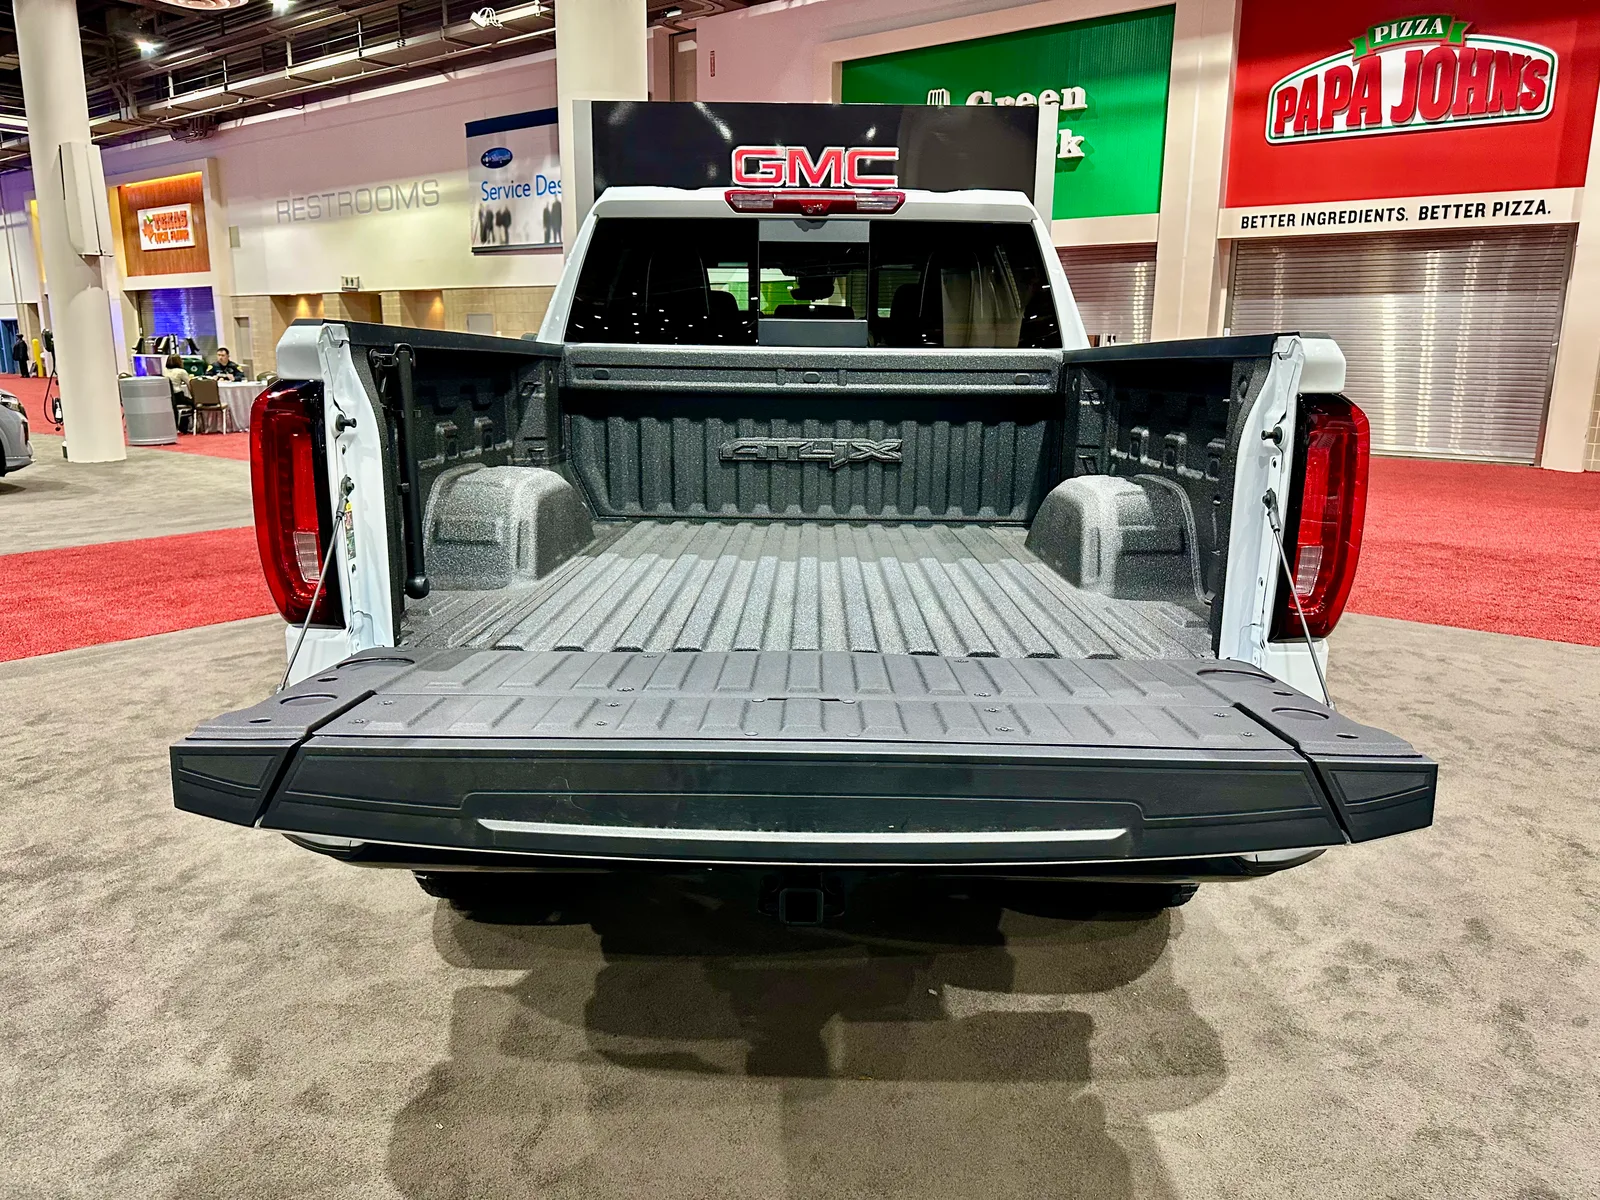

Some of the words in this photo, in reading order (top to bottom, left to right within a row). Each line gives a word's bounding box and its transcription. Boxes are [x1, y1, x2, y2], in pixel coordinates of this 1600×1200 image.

[1373, 17, 1444, 44] PIZZA
[1273, 55, 1382, 135] PAPA
[1390, 46, 1550, 125] JOHN'S
[731, 145, 899, 188] GMC
[276, 179, 439, 224] RESTROOMS
[481, 180, 531, 201] Service
[1241, 213, 1296, 229] BETTER
[1301, 206, 1409, 227] INGREDIENTS.
[1418, 202, 1486, 220] BETTER
[1492, 199, 1552, 217] PIZZA.
[719, 437, 902, 469] AT4X
